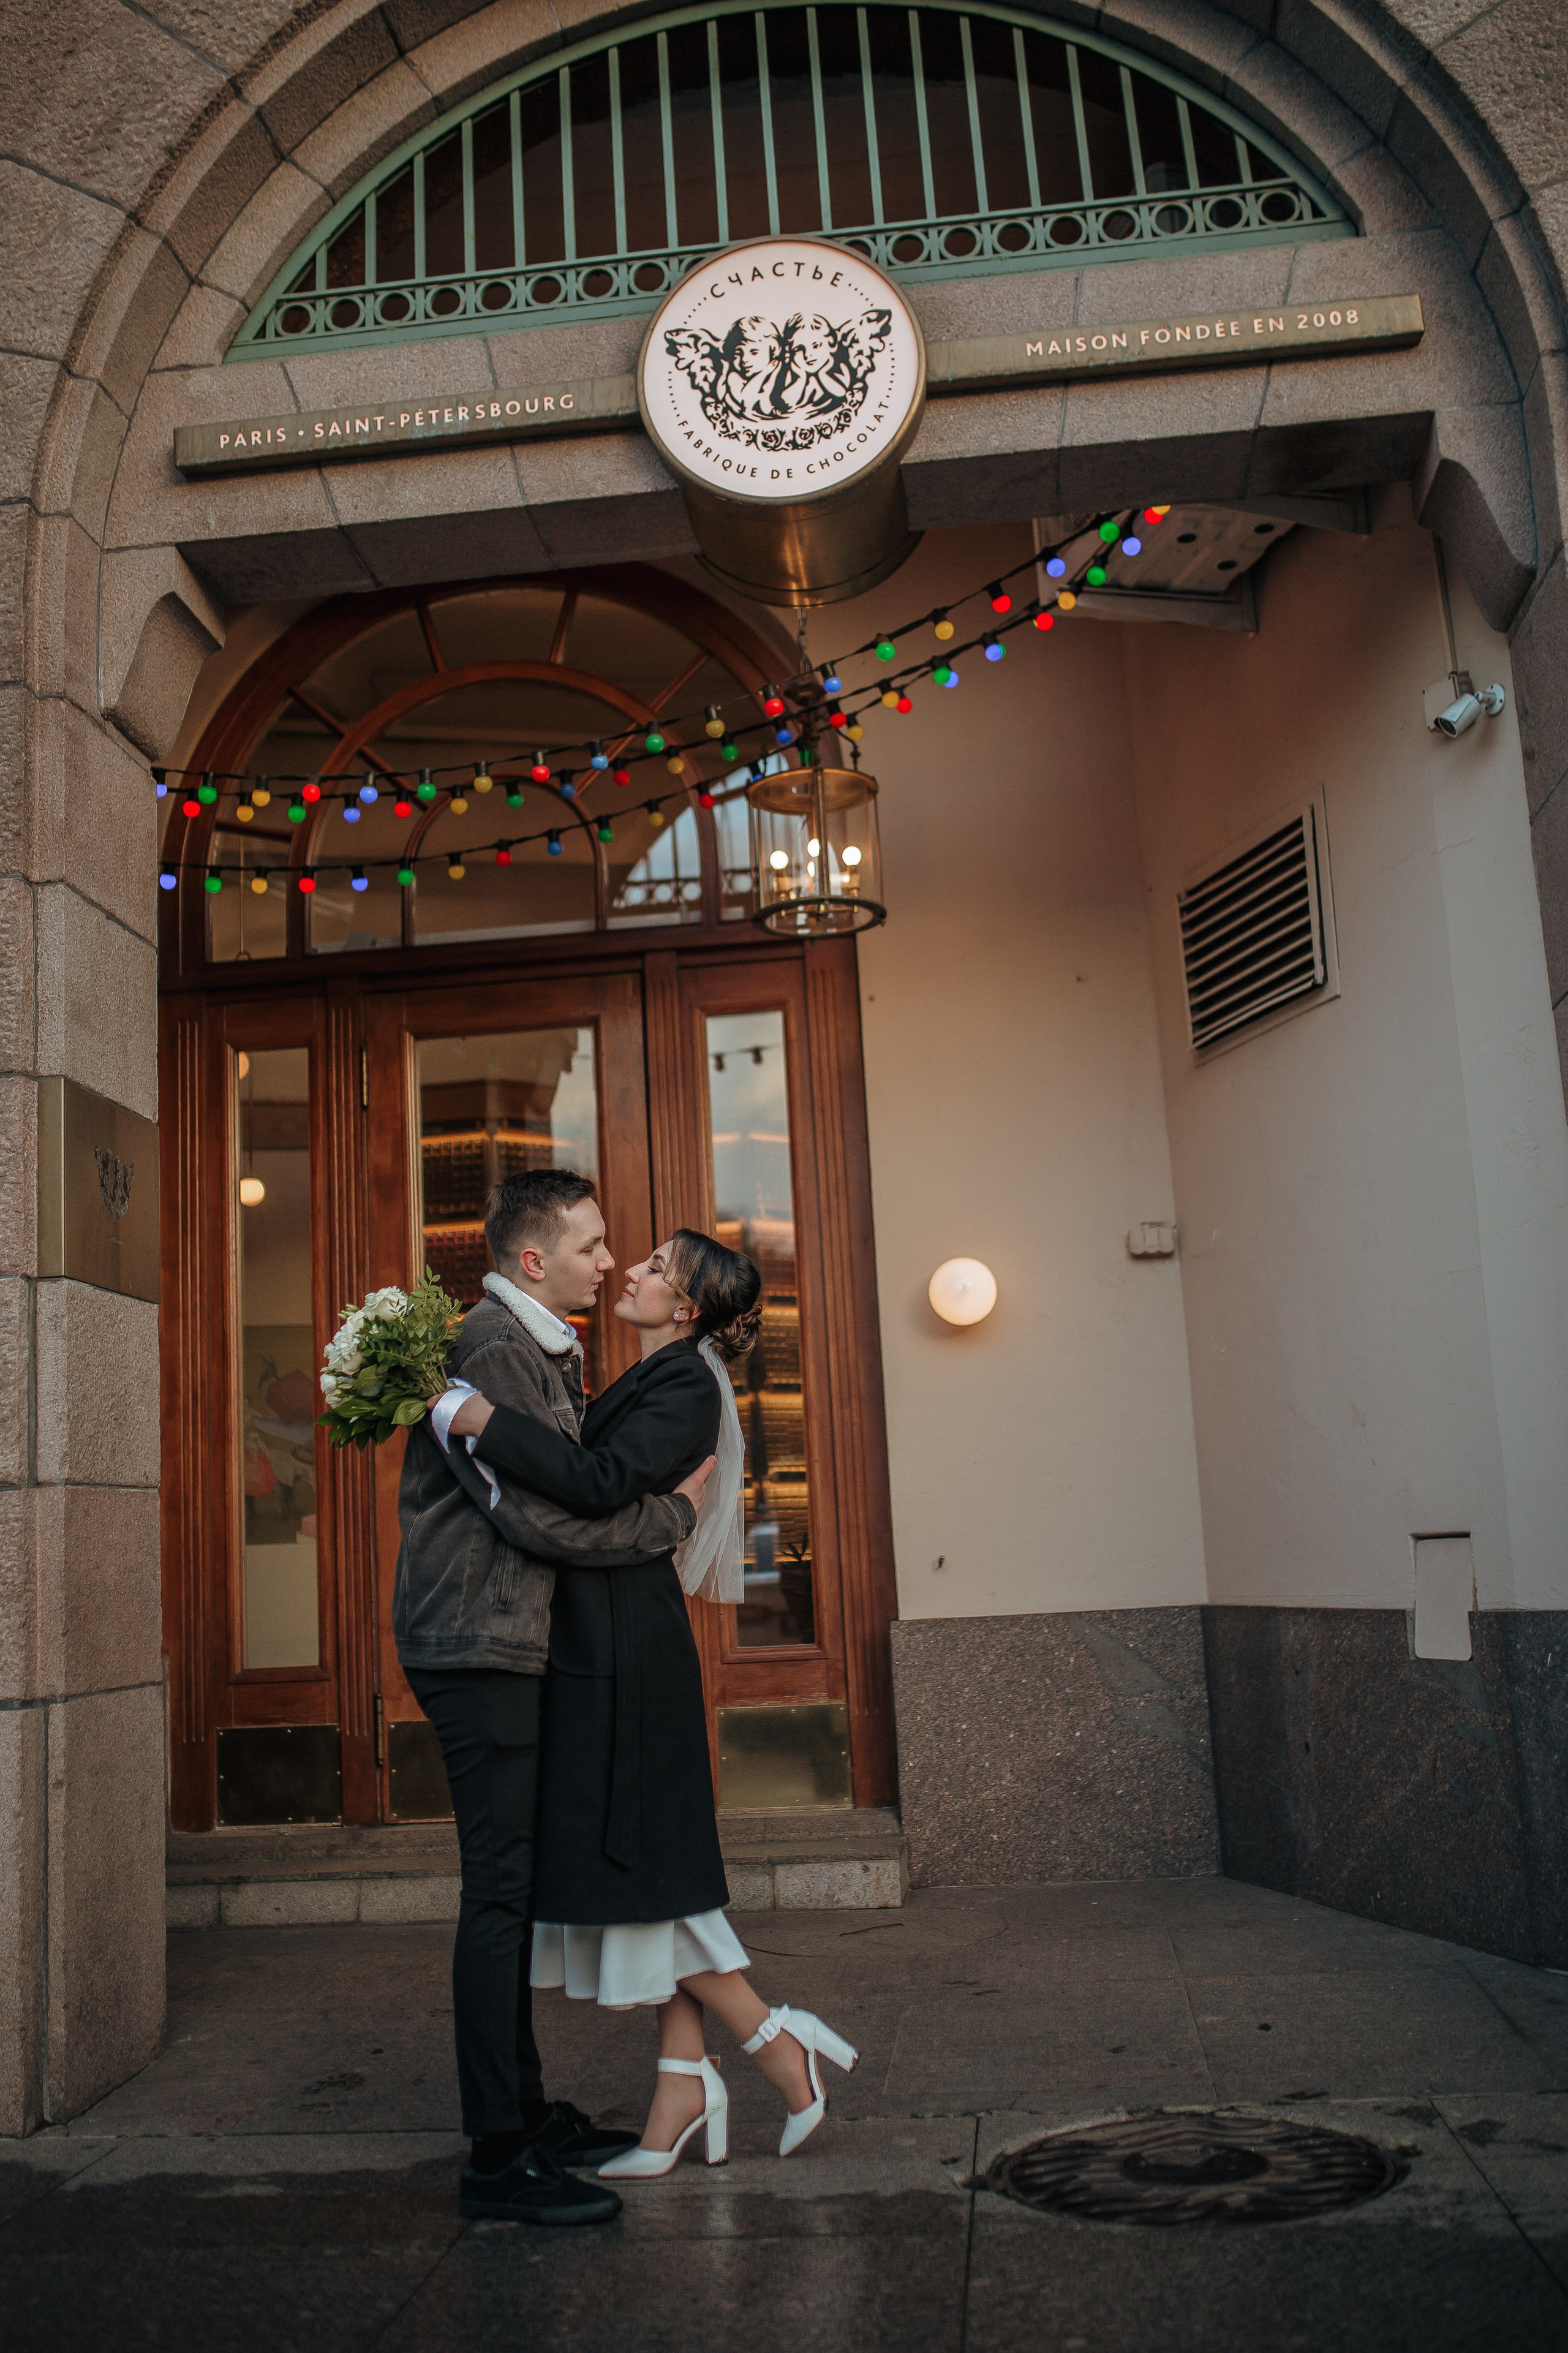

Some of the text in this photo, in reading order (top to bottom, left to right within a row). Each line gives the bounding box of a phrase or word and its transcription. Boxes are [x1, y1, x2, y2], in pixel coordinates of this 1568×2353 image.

[710, 262, 843, 298] СЧАСТЬЕ
[1026, 309, 1360, 357] MAISON FONDÉE EN 2008
[219, 428, 287, 448] PARIS
[677, 401, 890, 479] FABRIQUE DE CHOCOLAT
